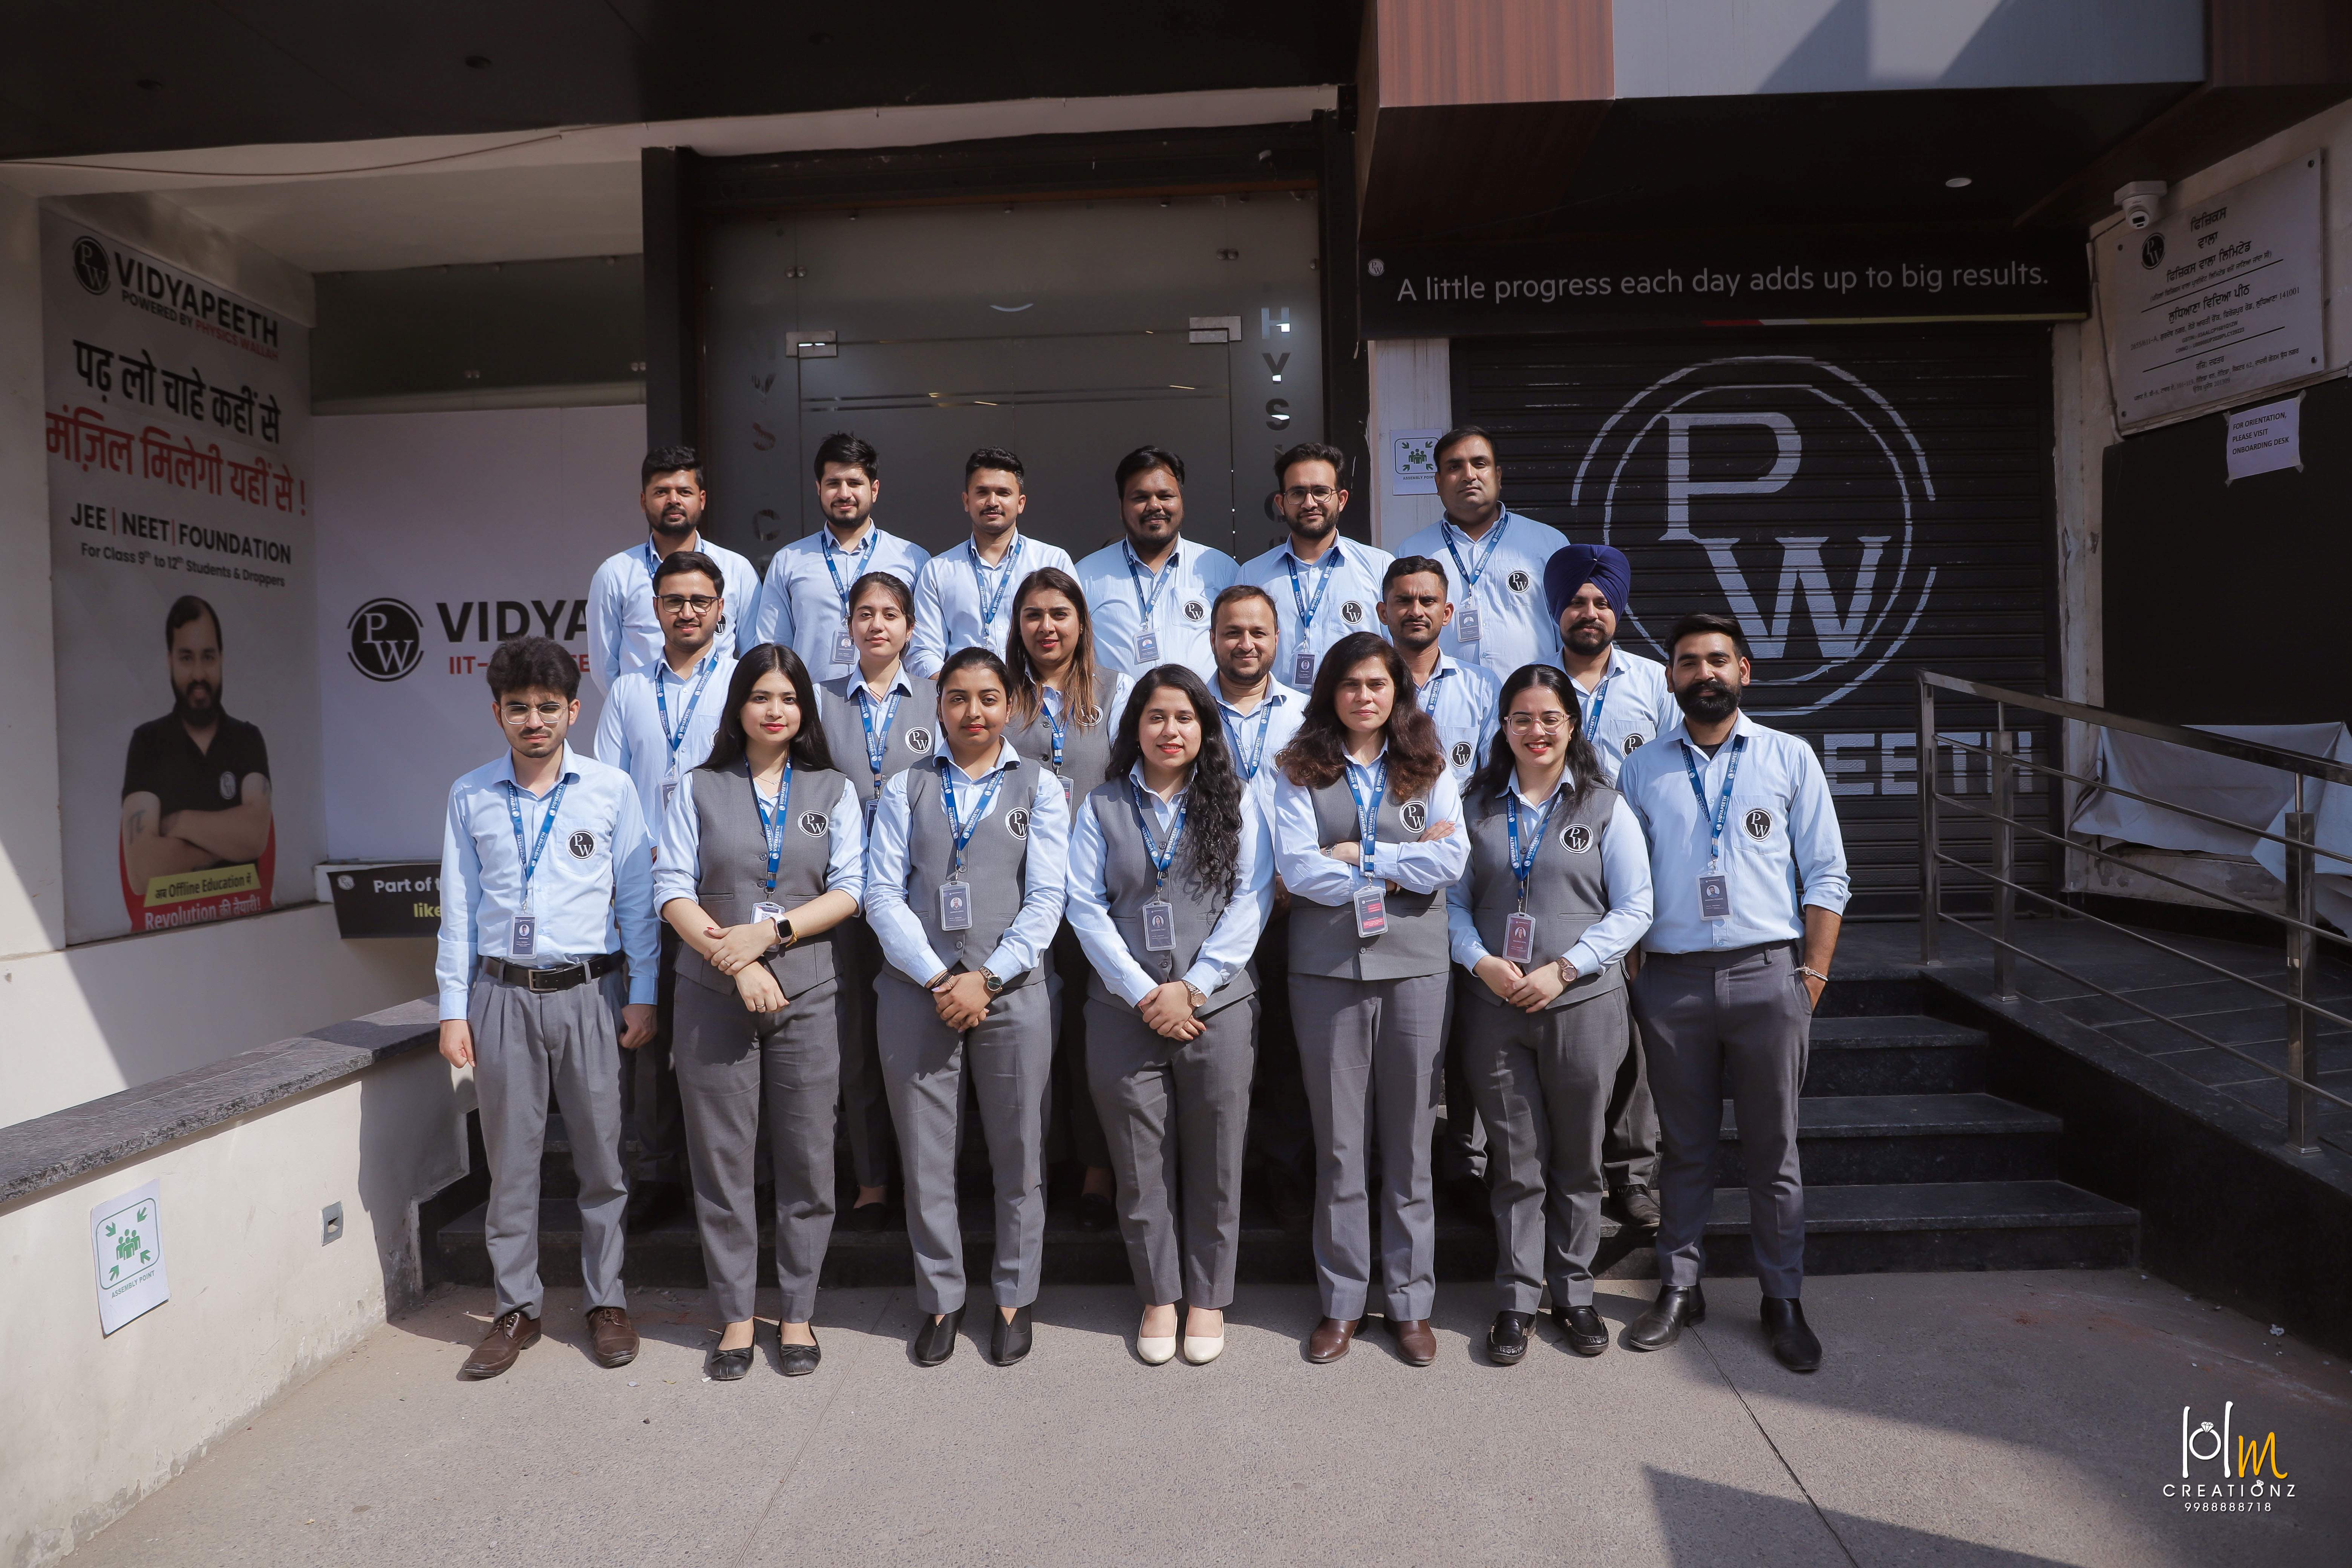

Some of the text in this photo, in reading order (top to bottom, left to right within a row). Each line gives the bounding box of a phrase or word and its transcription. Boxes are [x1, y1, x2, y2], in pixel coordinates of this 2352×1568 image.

[2197, 232, 2218, 248] ਵਾਲਾ
[2198, 255, 2216, 269] ਵਾਲਾ
[1397, 261, 2049, 303] A little progress each day adds up to big results.
[2234, 284, 2250, 297] ਪੀਠ
[2279, 287, 2300, 299] 141001
[115, 251, 278, 348] VIDYAPEETH
[122, 289, 178, 322] POWERED
[179, 314, 193, 327] BY
[73, 339, 280, 444] पढ़ लो चाहे कहीं से
[2245, 412, 2287, 427] ORIENTATION,
[2232, 429, 2268, 443] PLEASE VISIT
[2232, 436, 2289, 455] ONBOARDING DESK
[140, 426, 224, 496] मिलेगी
[227, 456, 273, 507] यहीं
[71, 503, 291, 565] JEE NEET FOUNDATION
[81, 543, 100, 558] For
[104, 547, 136, 564] Class
[154, 555, 166, 568] to
[186, 560, 231, 579] Students
[234, 570, 240, 580] &
[243, 570, 285, 588] Droppers
[1513, 574, 1527, 591] PW
[1188, 604, 1202, 619] PW
[1346, 604, 1360, 622] PW
[363, 613, 414, 672] PW
[1587, 715, 1596, 741] VIDYAPEETH
[912, 732, 928, 750] PW
[1456, 745, 1469, 764] PW
[948, 807, 956, 833] VIDYAPEETH
[965, 808, 980, 832] VIDYAPEETH
[1408, 807, 1424, 828] PW
[1717, 795, 1727, 823] VIDYAPEETH
[806, 815, 825, 833] PW
[1014, 813, 1027, 835] PW
[1752, 812, 1768, 838] PW
[533, 831, 546, 861] VIDYAPEETH
[574, 835, 592, 856] PW
[1165, 828, 1178, 853] VIDYAPEETH
[1526, 833, 1540, 860] VIDYAPEETH
[1569, 828, 1587, 850] PW
[169, 881, 200, 897] Offline
[202, 874, 245, 892] Education
[374, 877, 432, 893] Part of
[145, 902, 217, 930] Revolution
[413, 903, 441, 917] like
[112, 1270, 155, 1299] ASSEMBLY POINT
